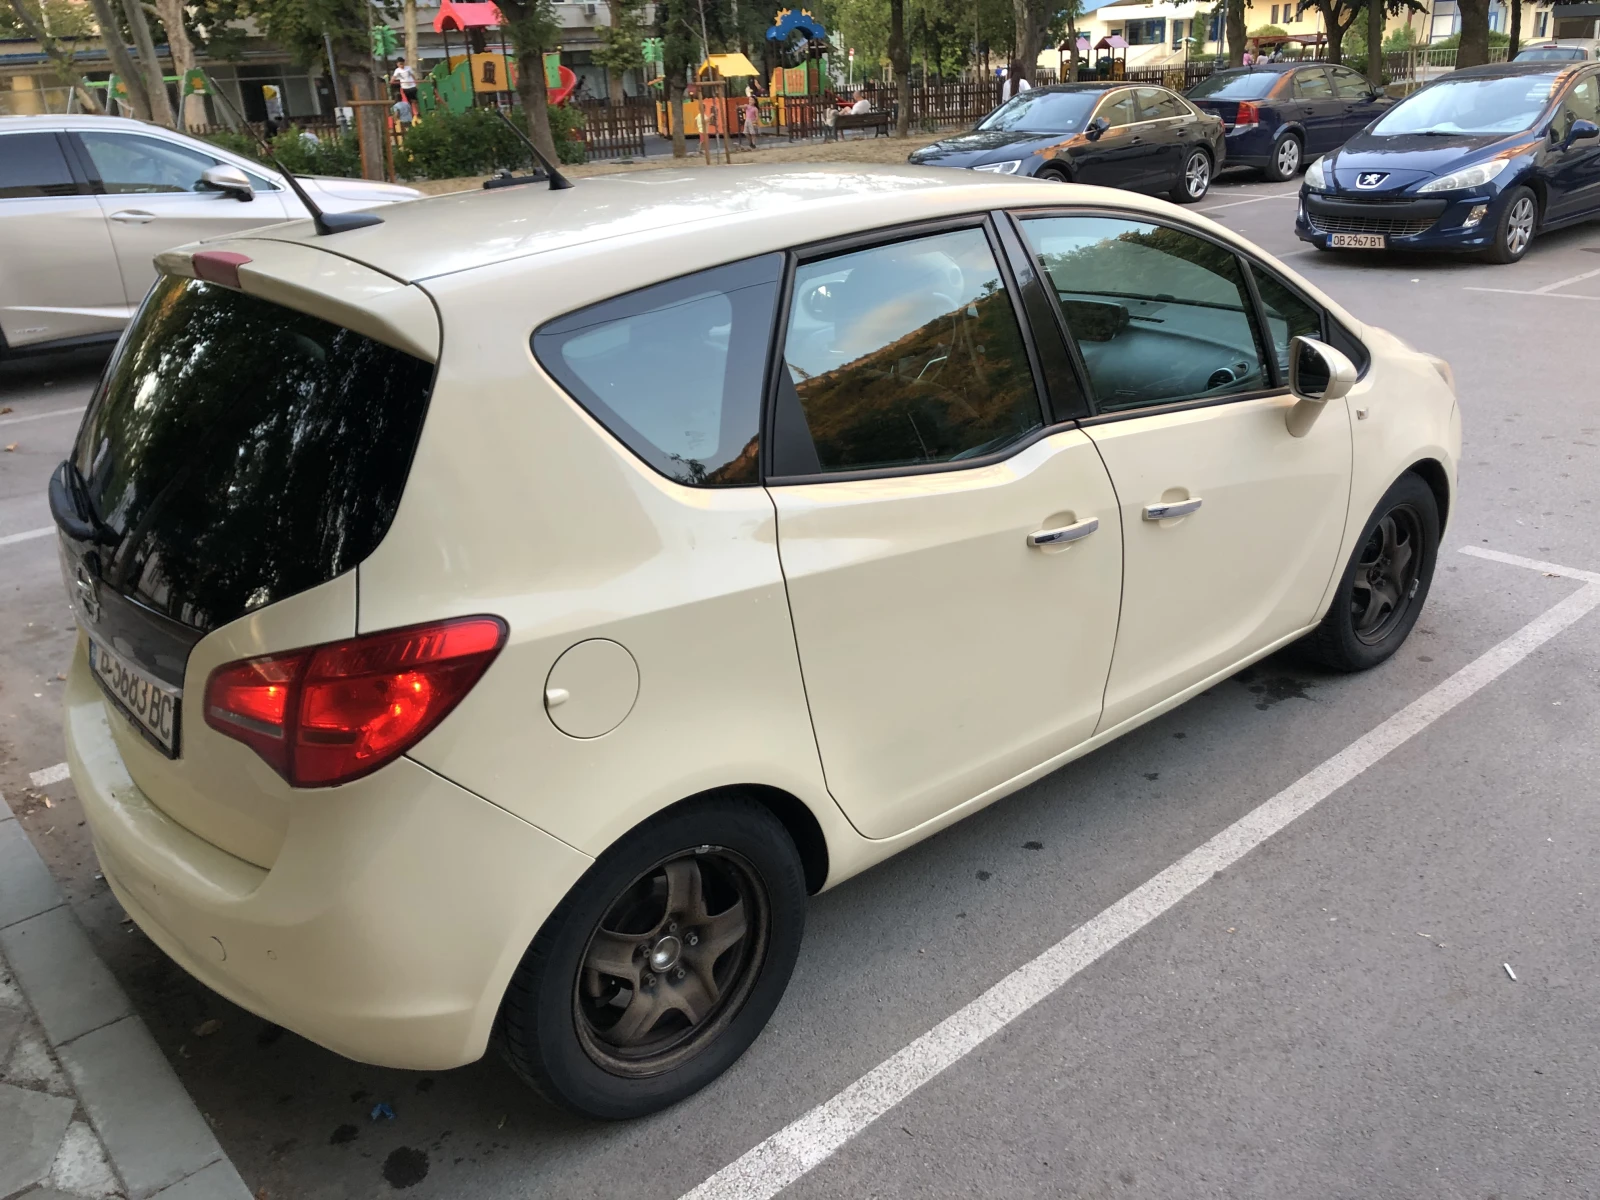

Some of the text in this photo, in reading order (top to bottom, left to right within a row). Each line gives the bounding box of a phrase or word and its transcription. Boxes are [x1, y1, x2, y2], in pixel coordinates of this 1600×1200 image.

[1333, 235, 1382, 247] OB 2967 BT
[149, 685, 172, 740] BC
